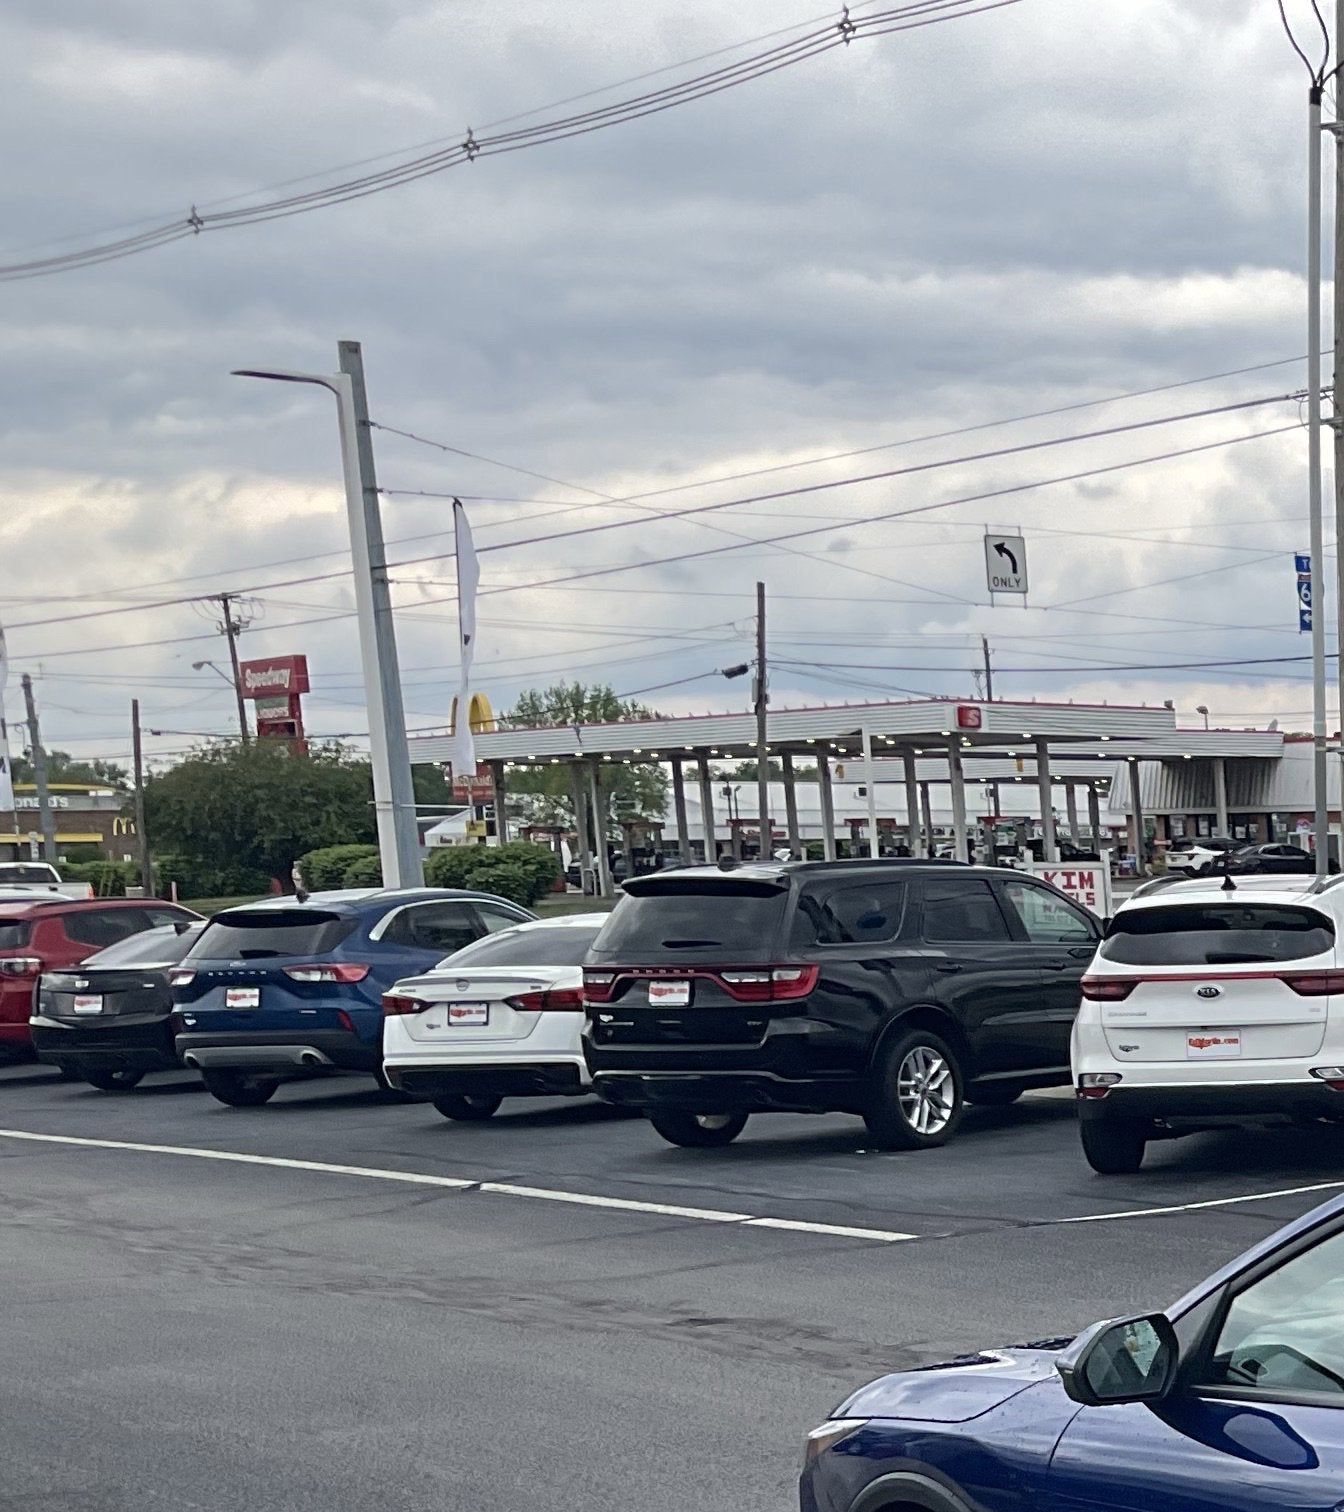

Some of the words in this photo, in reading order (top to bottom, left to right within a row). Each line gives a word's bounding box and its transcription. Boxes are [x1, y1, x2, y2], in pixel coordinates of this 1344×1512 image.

[992, 576, 1022, 588] ONLY
[1301, 583, 1311, 602] 6
[245, 666, 291, 693] Speedway
[1043, 871, 1095, 890] KIM
